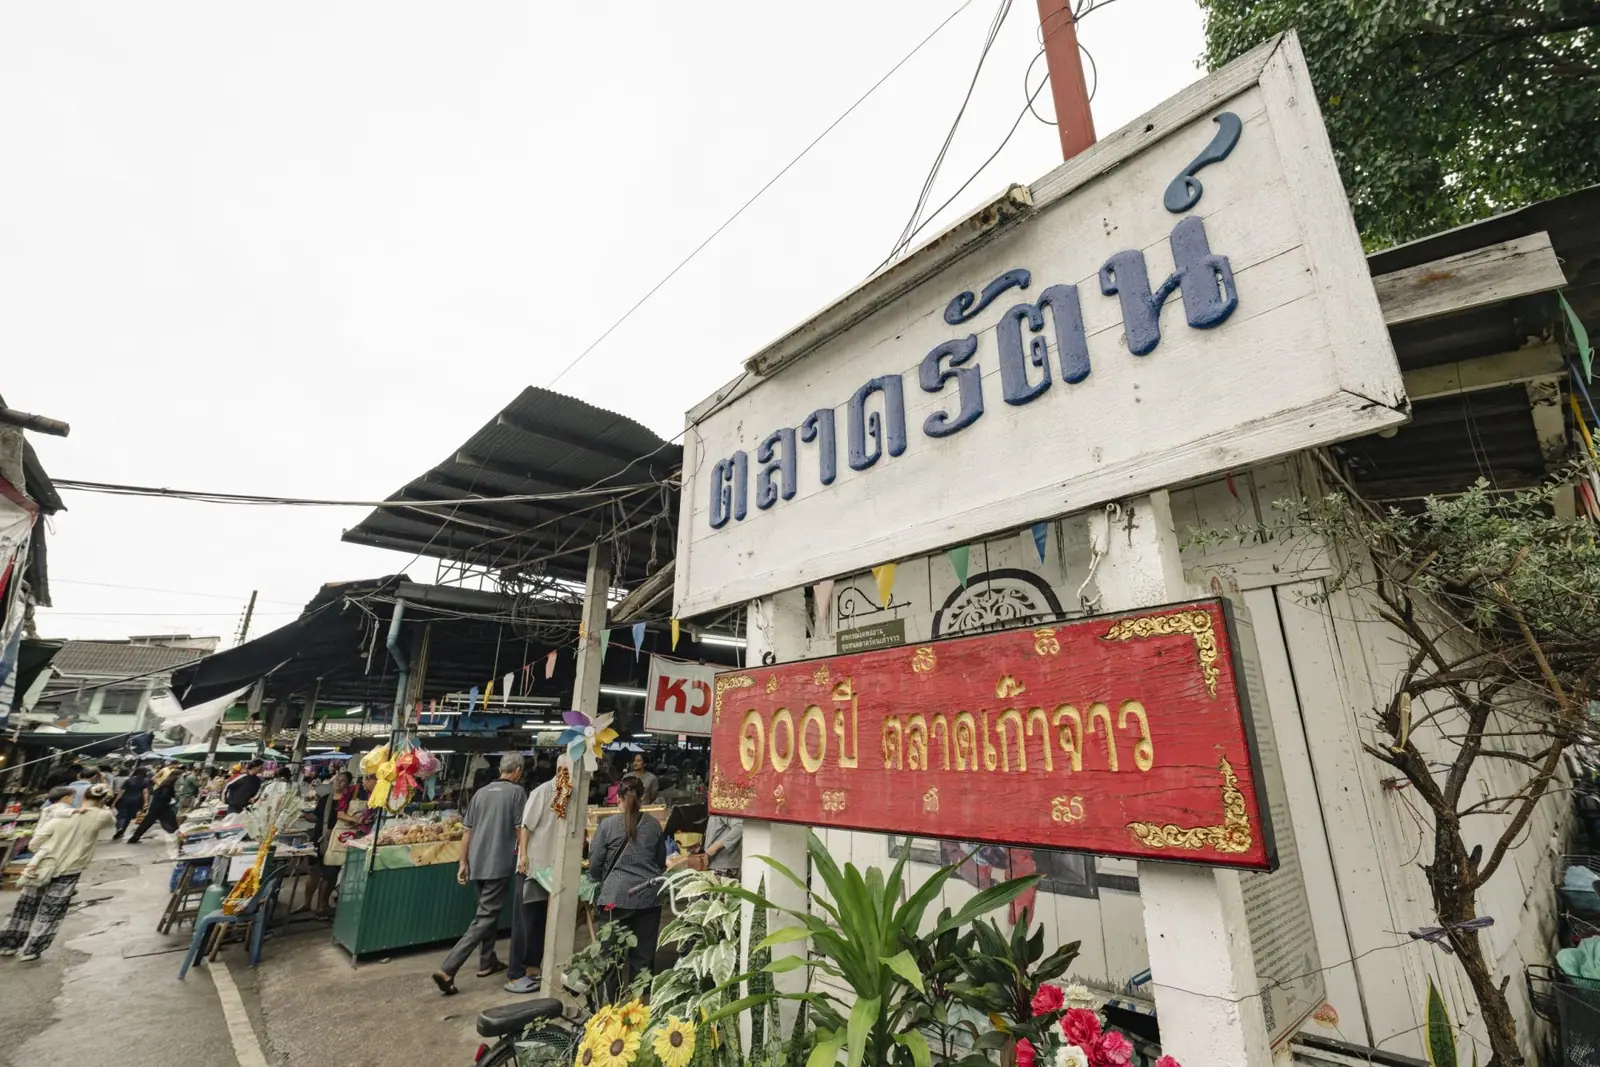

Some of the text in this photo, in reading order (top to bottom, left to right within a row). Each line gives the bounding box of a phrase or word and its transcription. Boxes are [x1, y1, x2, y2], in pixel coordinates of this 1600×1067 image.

[709, 112, 1242, 529] ตลาดรัตน์
[655, 675, 712, 716] หว
[739, 676, 858, 778] ๑๐๐ปี
[881, 674, 1154, 772] ตลาดเก๊าจาว
